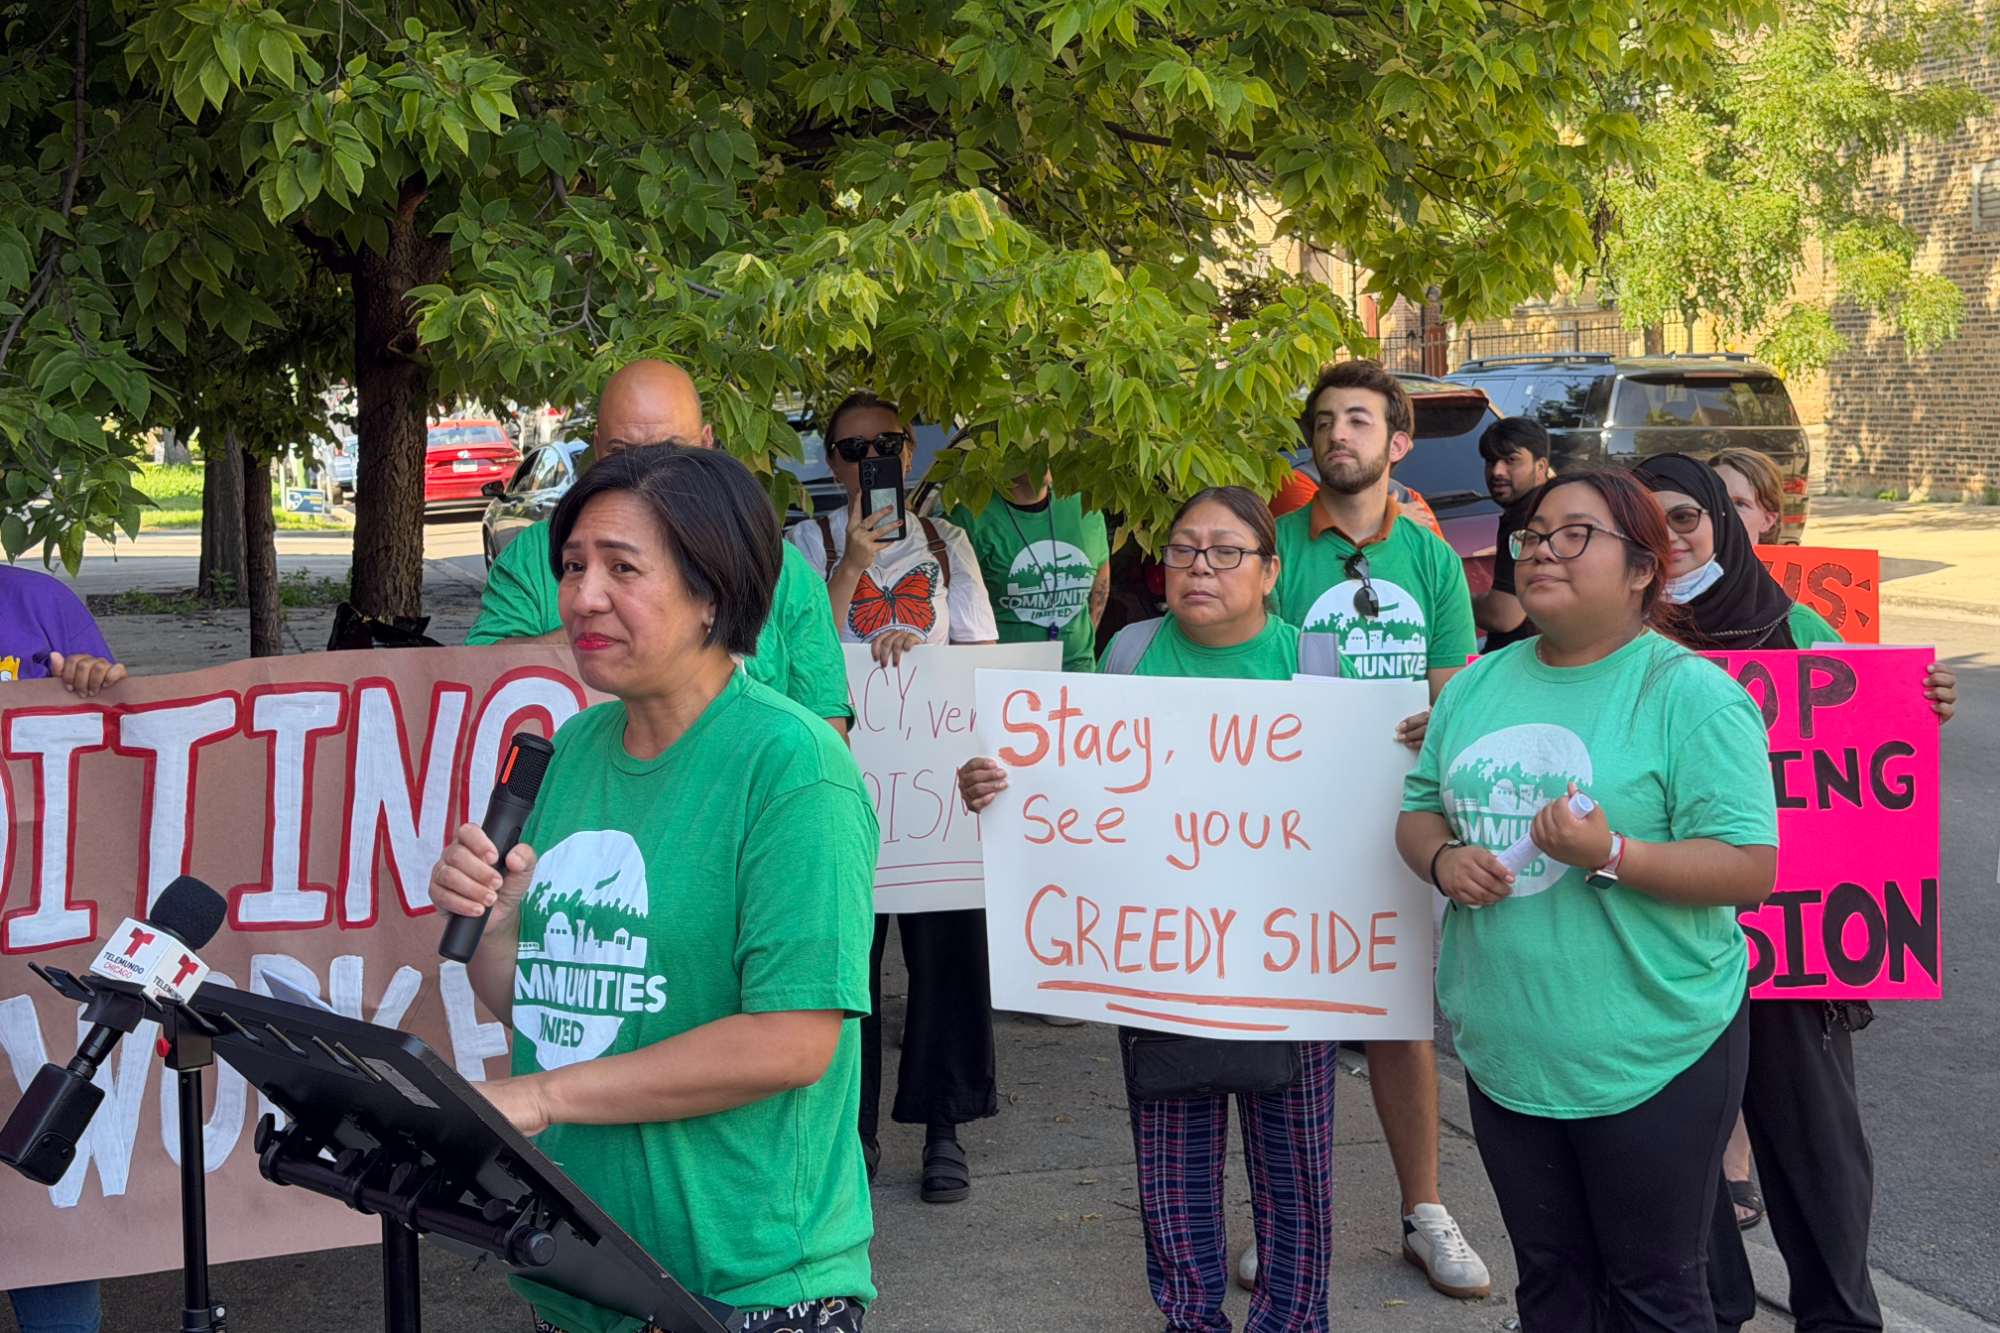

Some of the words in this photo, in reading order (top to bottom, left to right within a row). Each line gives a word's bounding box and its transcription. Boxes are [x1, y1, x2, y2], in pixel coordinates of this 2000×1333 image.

[1700, 654, 1857, 739] OP
[999, 686, 1173, 794] Stacy,
[1769, 740, 1915, 811] ING
[103, 952, 144, 974] TELEMUNDO
[1025, 884, 1236, 980] GREEDY
[1263, 907, 1398, 974] SIDE
[103, 962, 132, 979] CHICAGO
[515, 963, 667, 1013] MMUNITIES
